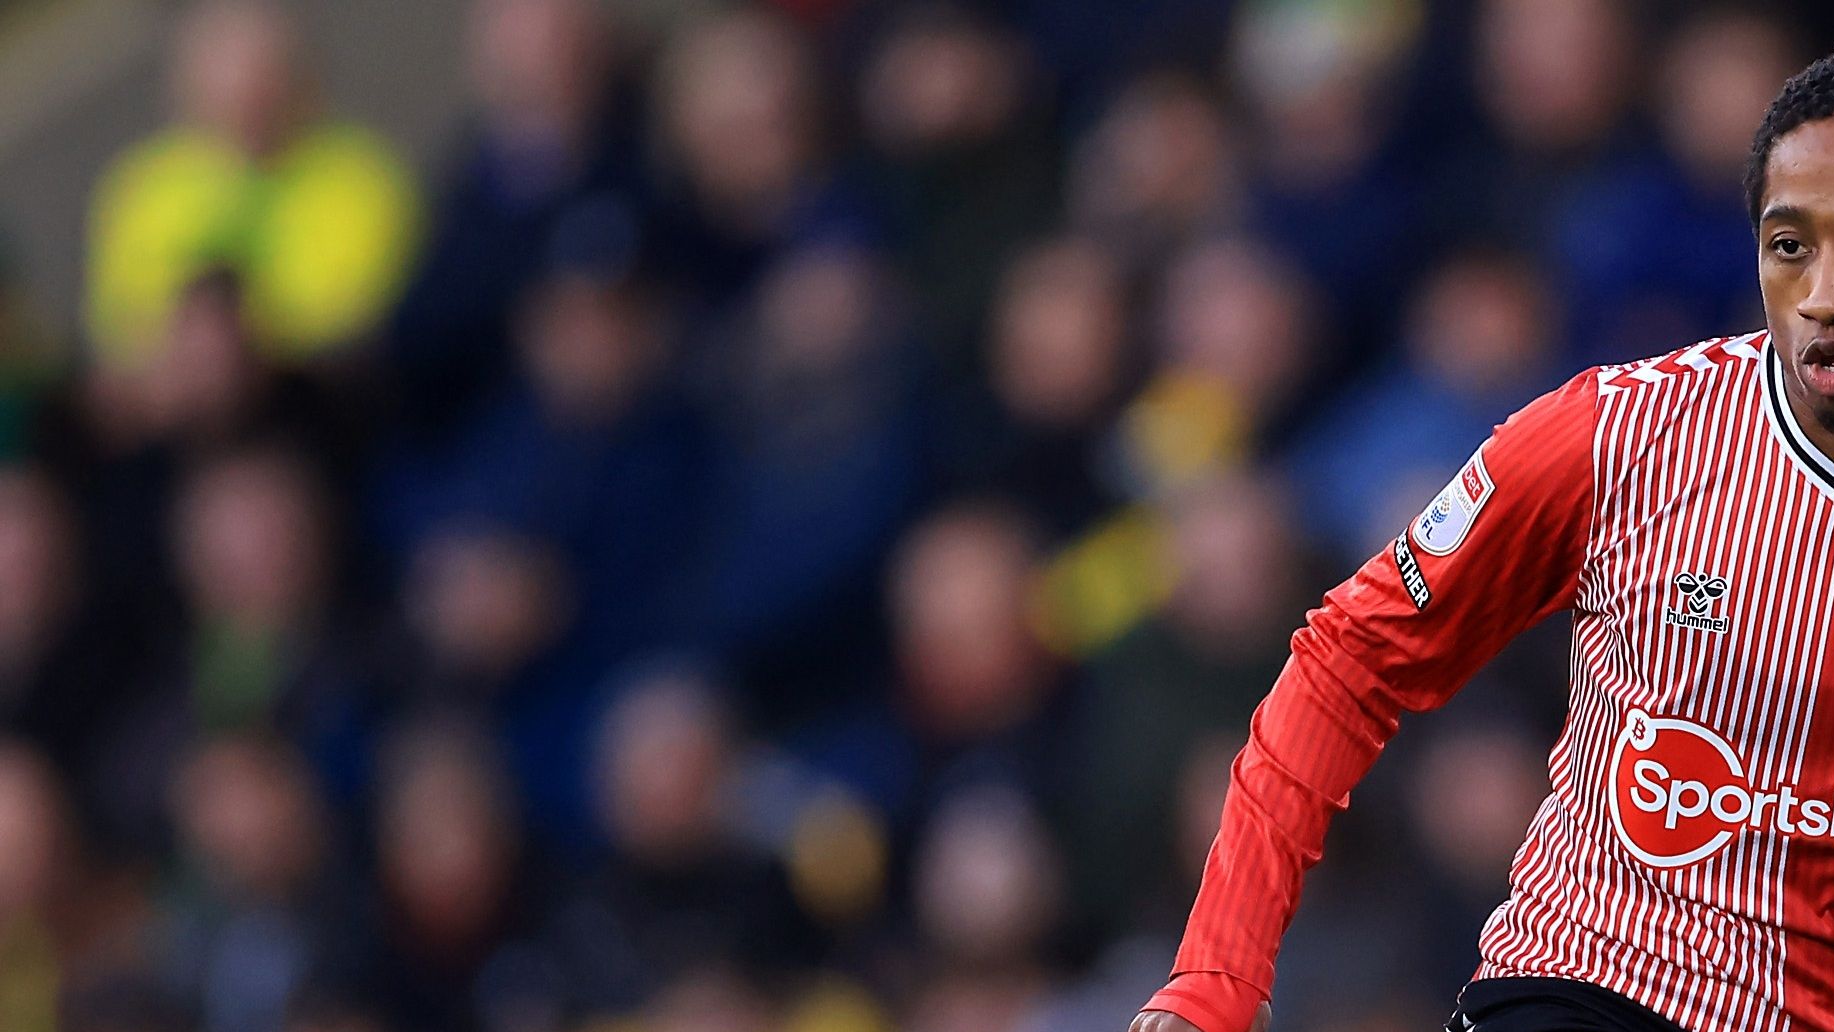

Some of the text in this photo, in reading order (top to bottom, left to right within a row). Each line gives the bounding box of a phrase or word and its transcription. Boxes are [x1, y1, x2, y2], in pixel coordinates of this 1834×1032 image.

[1465, 467, 1480, 498] bet
[1396, 530, 1429, 608] GETHER
[1665, 606, 1729, 633] hummel
